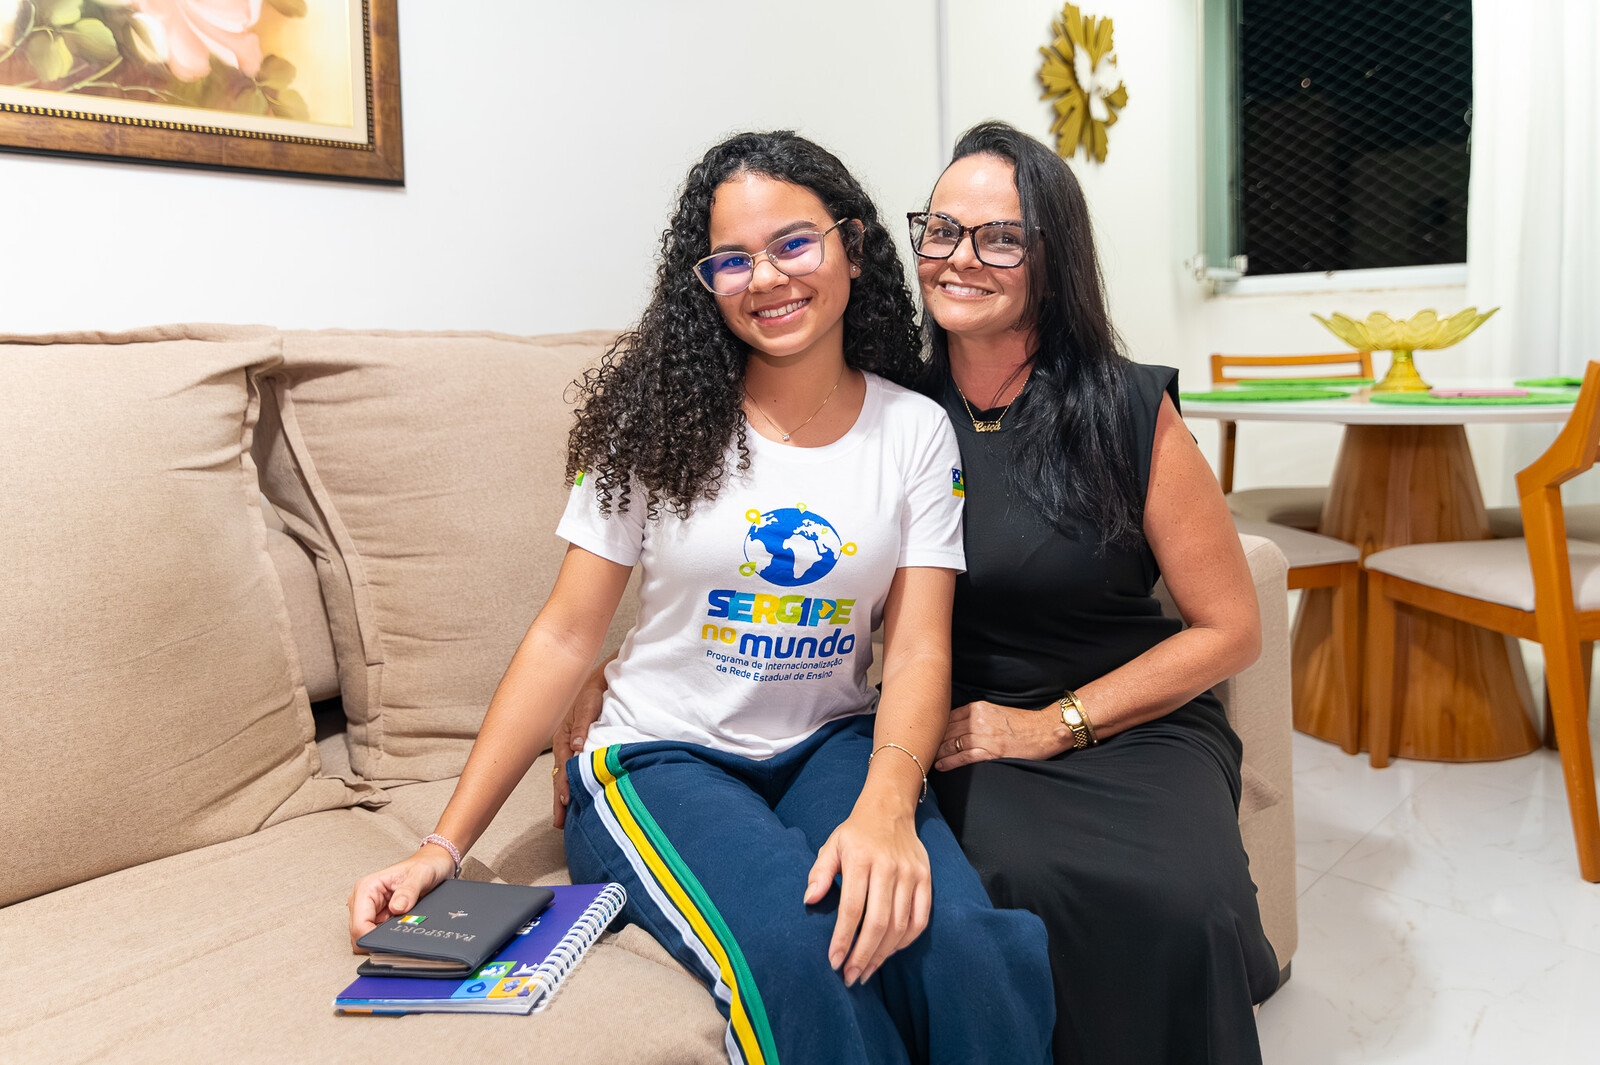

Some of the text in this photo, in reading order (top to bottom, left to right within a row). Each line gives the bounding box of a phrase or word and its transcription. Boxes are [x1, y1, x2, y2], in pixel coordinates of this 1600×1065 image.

[708, 589, 856, 627] SERGIPE
[701, 623, 855, 659] no mundo
[706, 650, 843, 671] Programa de Internacionalização
[716, 664, 833, 682] da Rede Estadual de Ensino
[390, 925, 476, 942] PASSPORT
